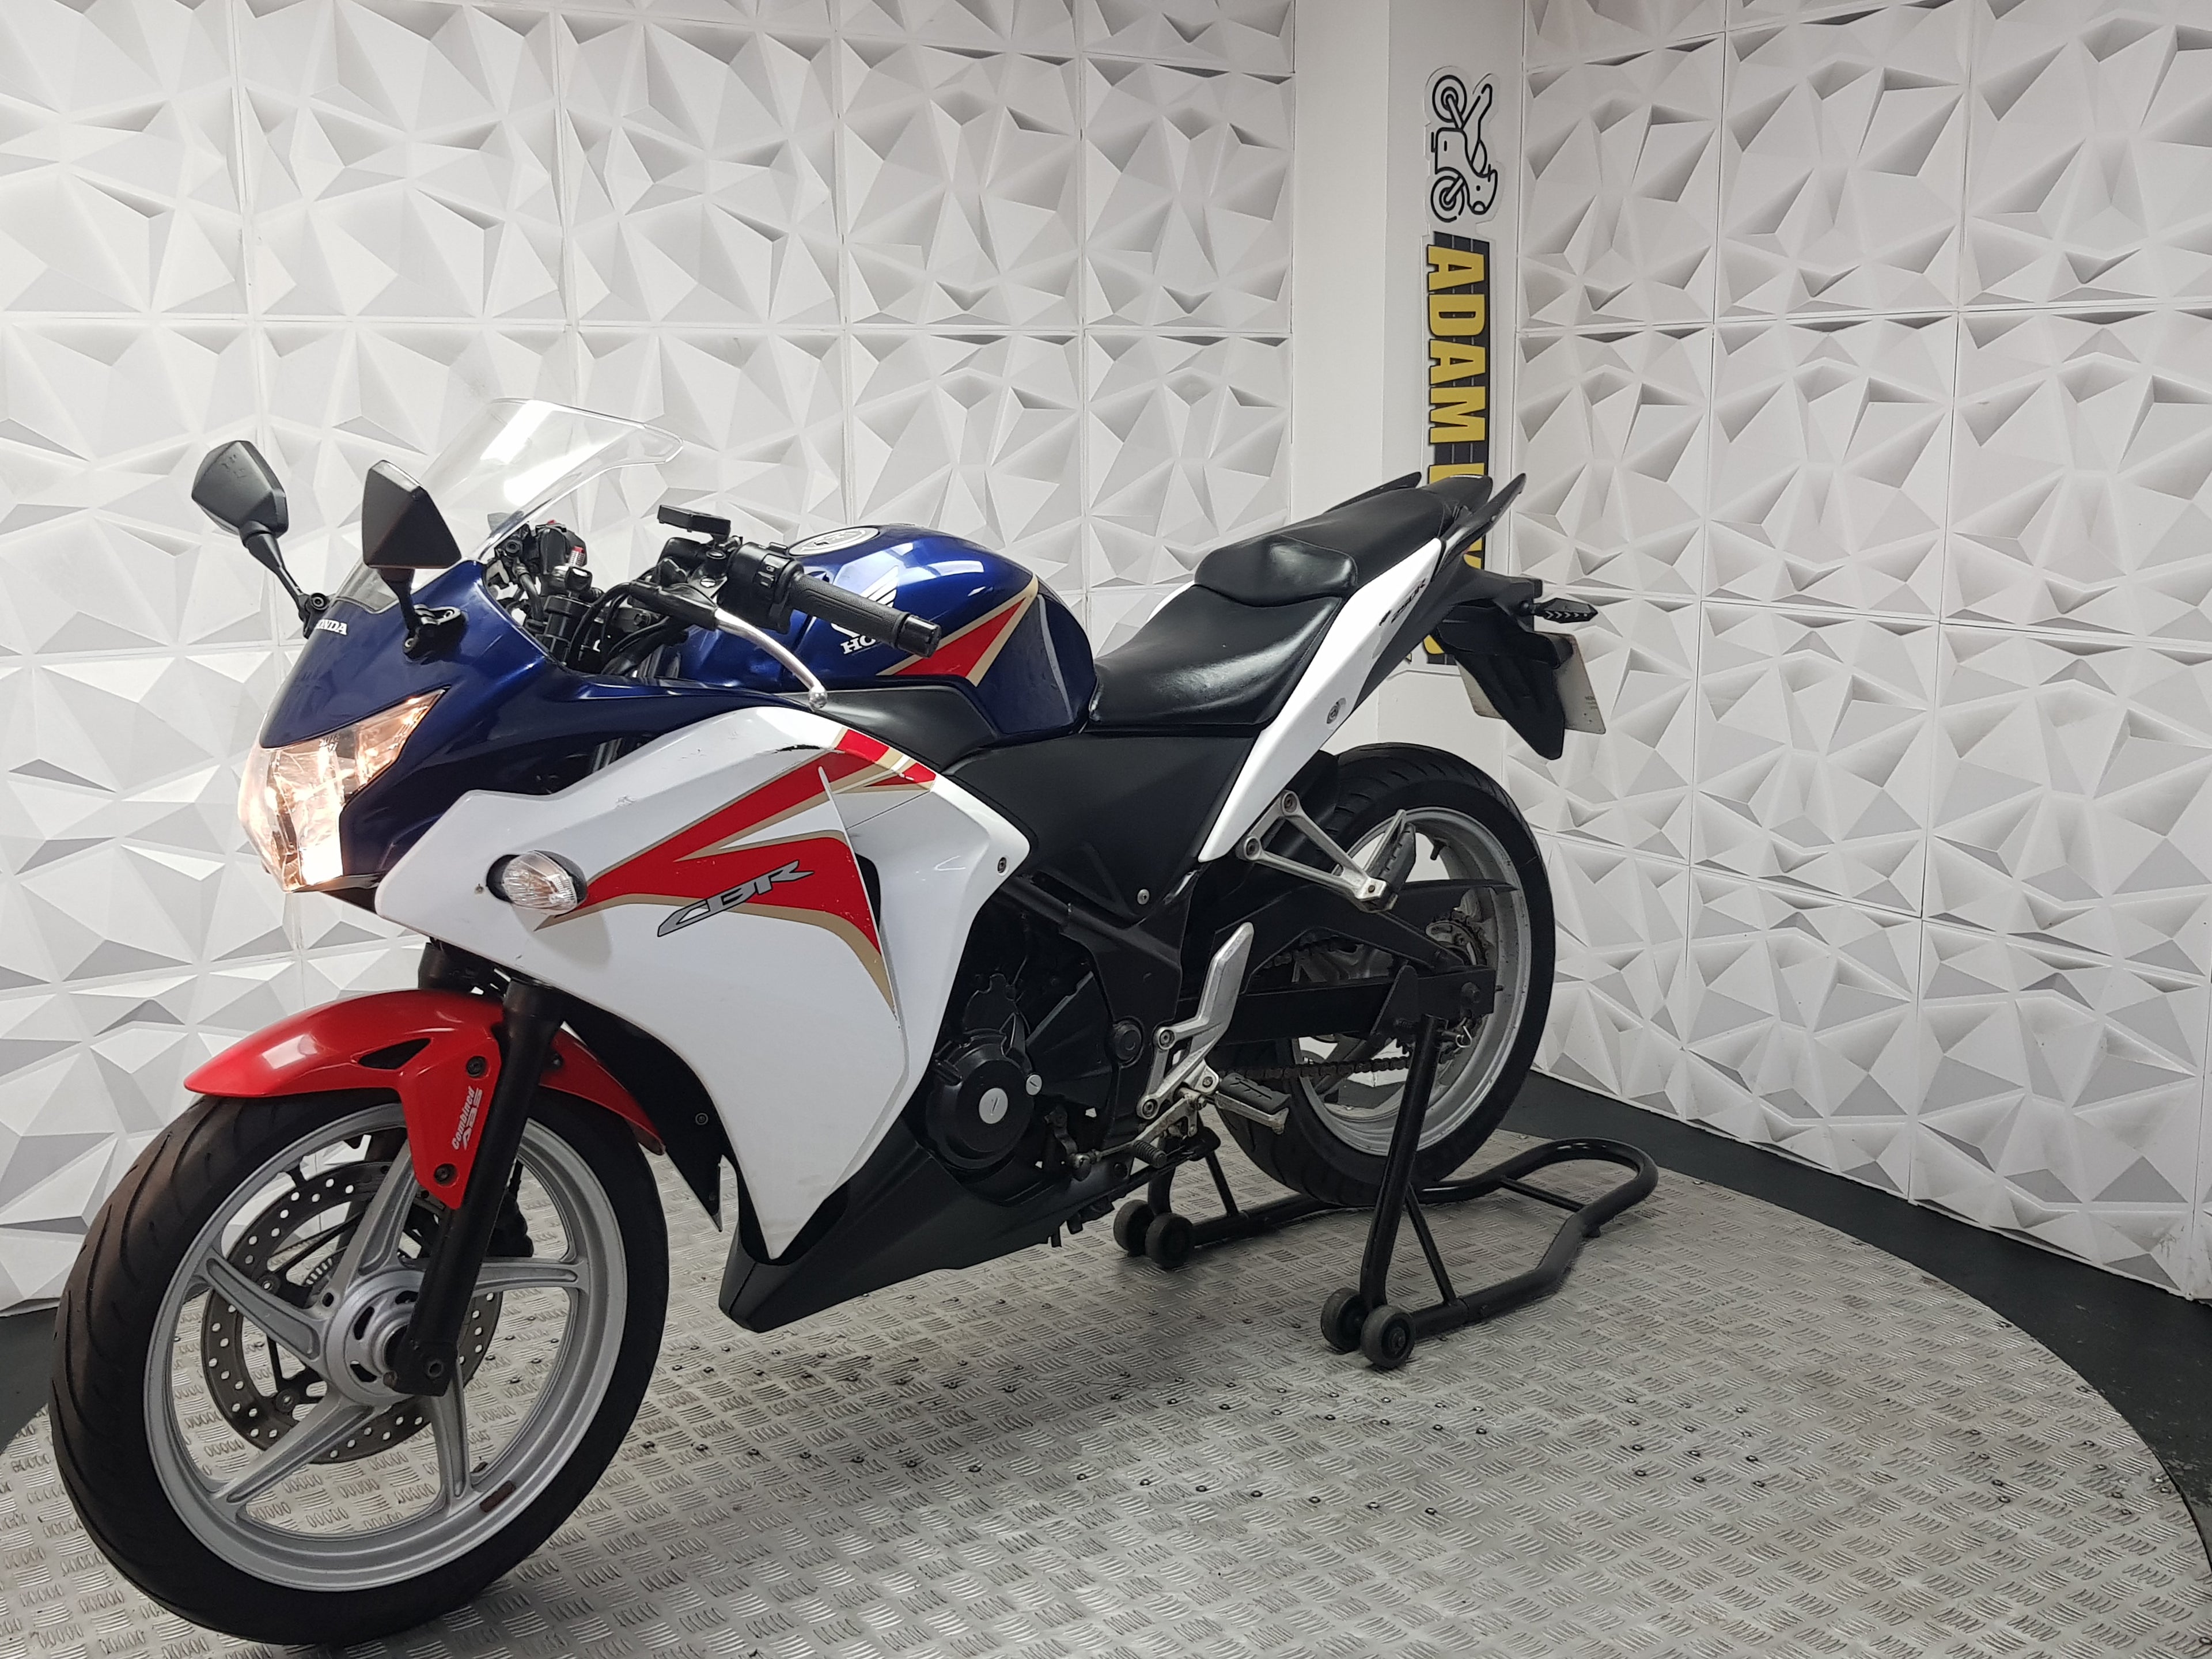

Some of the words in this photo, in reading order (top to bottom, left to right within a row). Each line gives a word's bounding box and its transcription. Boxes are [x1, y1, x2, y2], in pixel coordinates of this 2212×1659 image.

[1427, 244, 1486, 444] ADAM
[315, 619, 347, 635] ONDA
[657, 859, 815, 937] CBR
[452, 1085, 475, 1150] Combined
[463, 1087, 483, 1150] ABS
